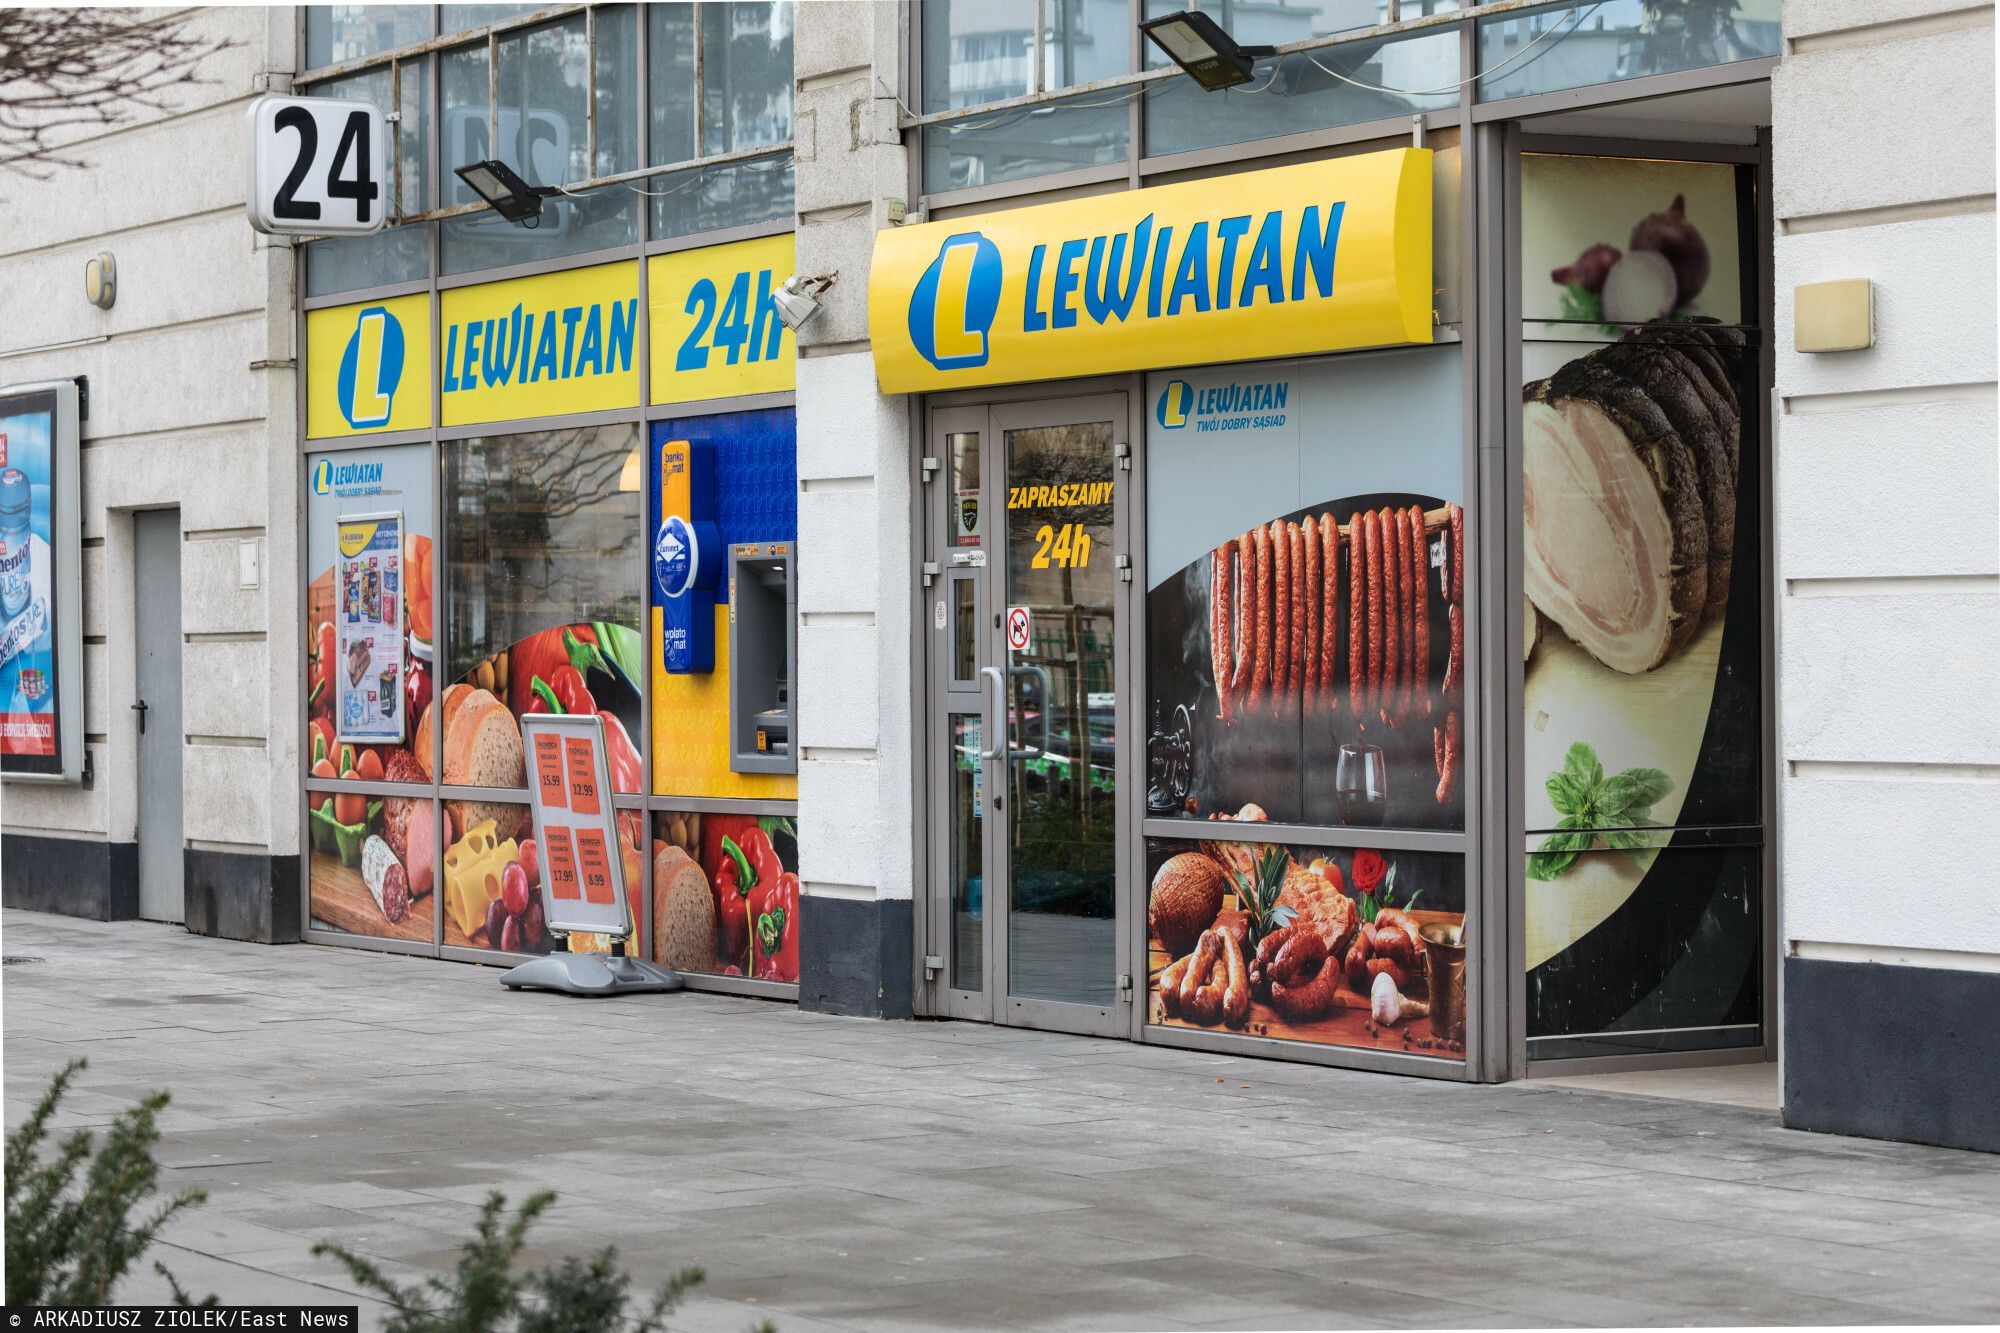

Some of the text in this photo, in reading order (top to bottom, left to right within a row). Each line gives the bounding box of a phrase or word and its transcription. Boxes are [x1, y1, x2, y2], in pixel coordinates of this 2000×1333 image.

[272, 105, 379, 223] 24
[1023, 201, 1346, 333] LEWIATAN
[443, 298, 639, 393] LEWIATAN
[674, 268, 785, 372] 24h
[1197, 382, 1289, 416] LEWIATAN
[1196, 414, 1286, 433] TWÓJ DOBRY SĄSIAD
[665, 451, 684, 464] banko
[335, 462, 383, 486] LEWIATAN
[672, 463, 684, 473] mat
[1007, 481, 1114, 510] ZAPRASZAMY
[1031, 523, 1092, 570] 24h
[673, 638, 686, 650] mat
[543, 775, 561, 787] 15.99
[573, 784, 593, 798] 12.99
[553, 869, 574, 883] 17.99
[588, 874, 605, 887] 8.99
